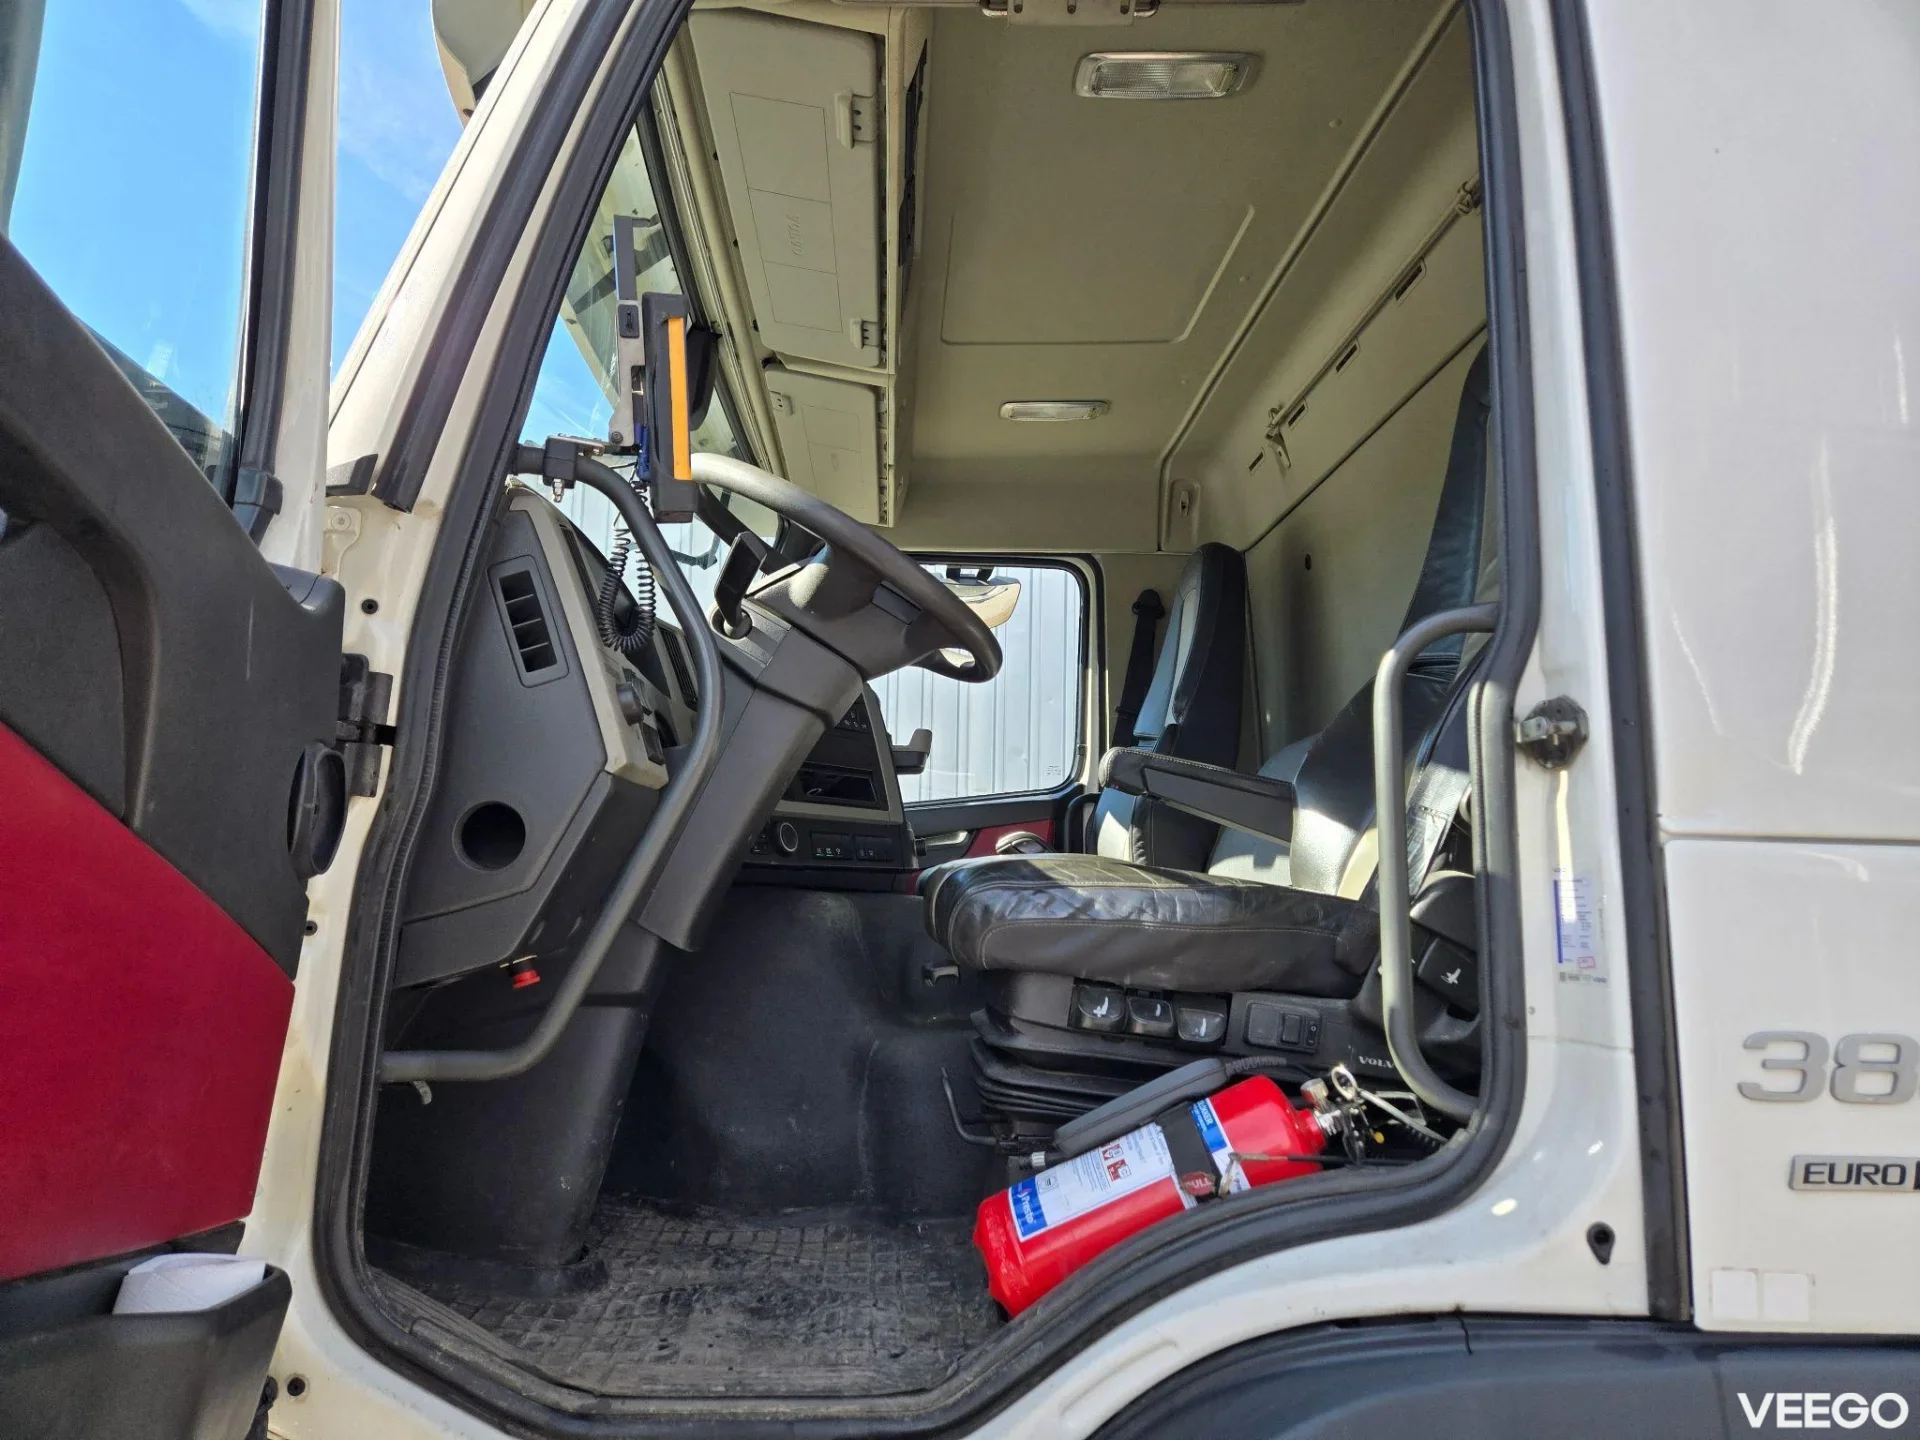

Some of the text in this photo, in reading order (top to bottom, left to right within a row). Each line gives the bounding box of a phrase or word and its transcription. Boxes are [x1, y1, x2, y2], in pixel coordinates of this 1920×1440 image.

[1358, 1055, 1394, 1069] VOLV
[1737, 1031, 1920, 1105] 38
[1802, 1162, 1907, 1187] EURO
[1021, 1195, 1034, 1224] Presto
